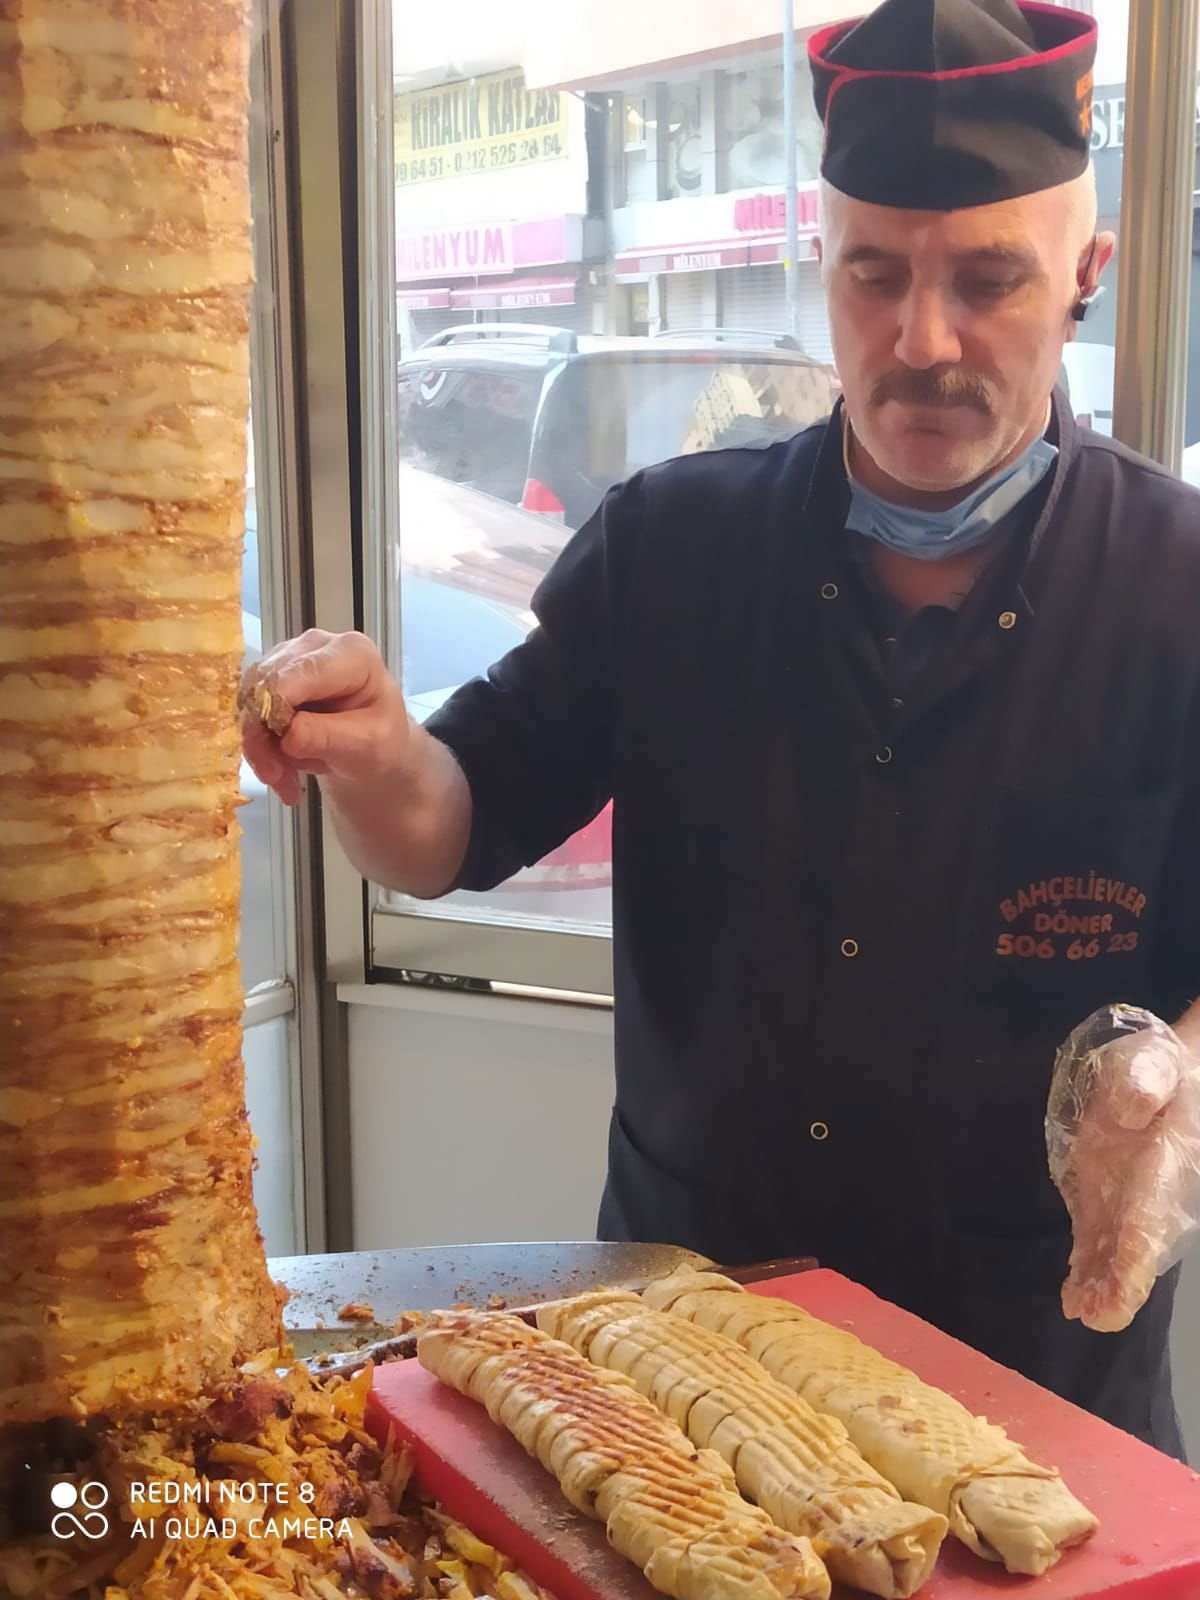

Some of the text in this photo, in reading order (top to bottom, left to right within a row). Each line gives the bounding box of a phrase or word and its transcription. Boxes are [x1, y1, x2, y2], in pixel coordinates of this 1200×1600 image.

[429, 155, 443, 177] 51
[1034, 908, 1113, 934] DÖNER
[1066, 938, 1099, 960] 66
[1107, 931, 1139, 953] 23
